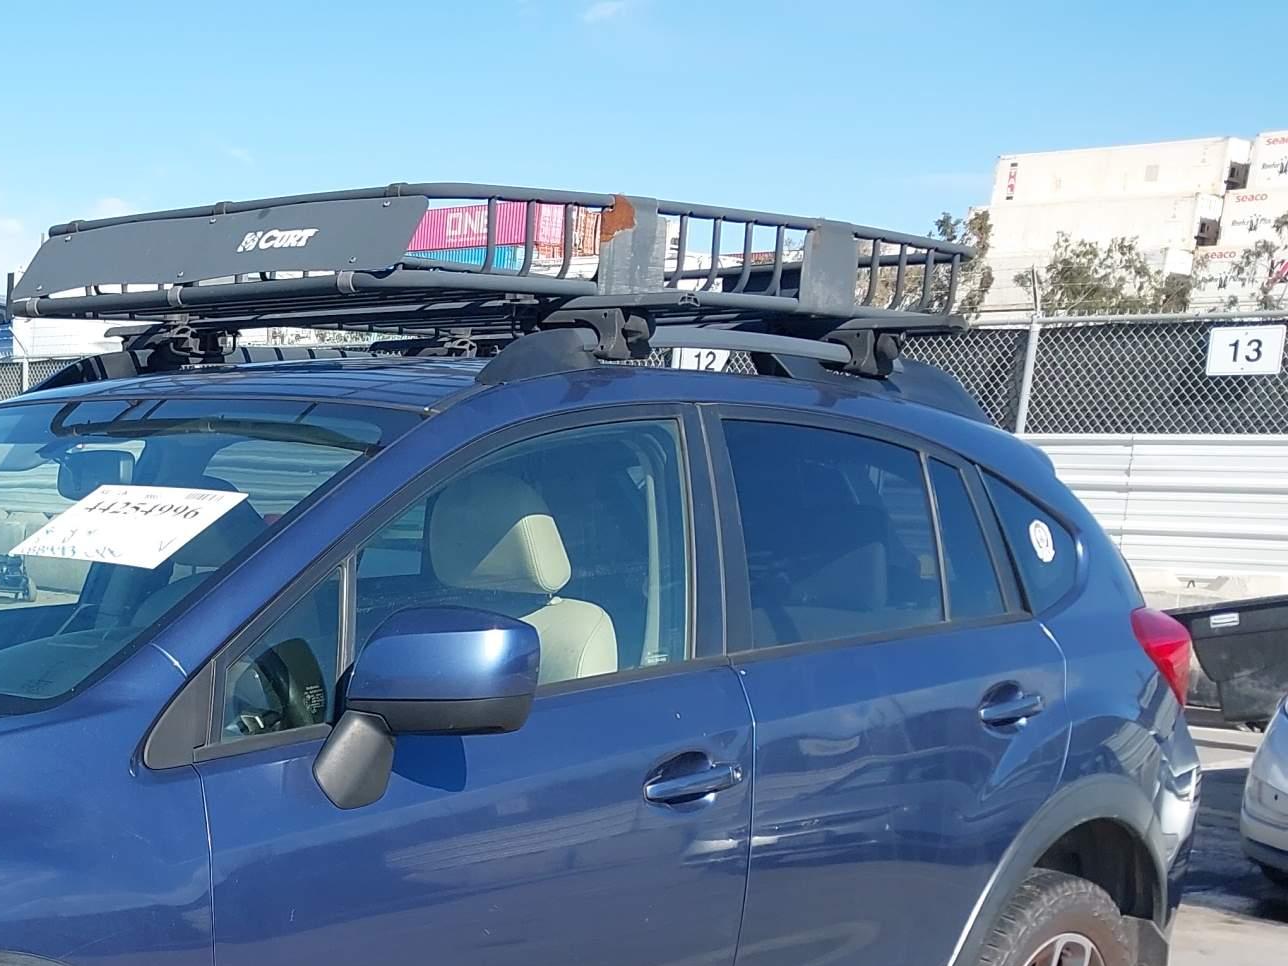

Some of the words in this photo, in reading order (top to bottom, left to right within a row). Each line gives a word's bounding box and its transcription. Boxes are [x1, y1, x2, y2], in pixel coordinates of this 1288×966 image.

[259, 228, 321, 250] CURT
[693, 350, 717, 370] 12
[1228, 338, 1263, 363] 13
